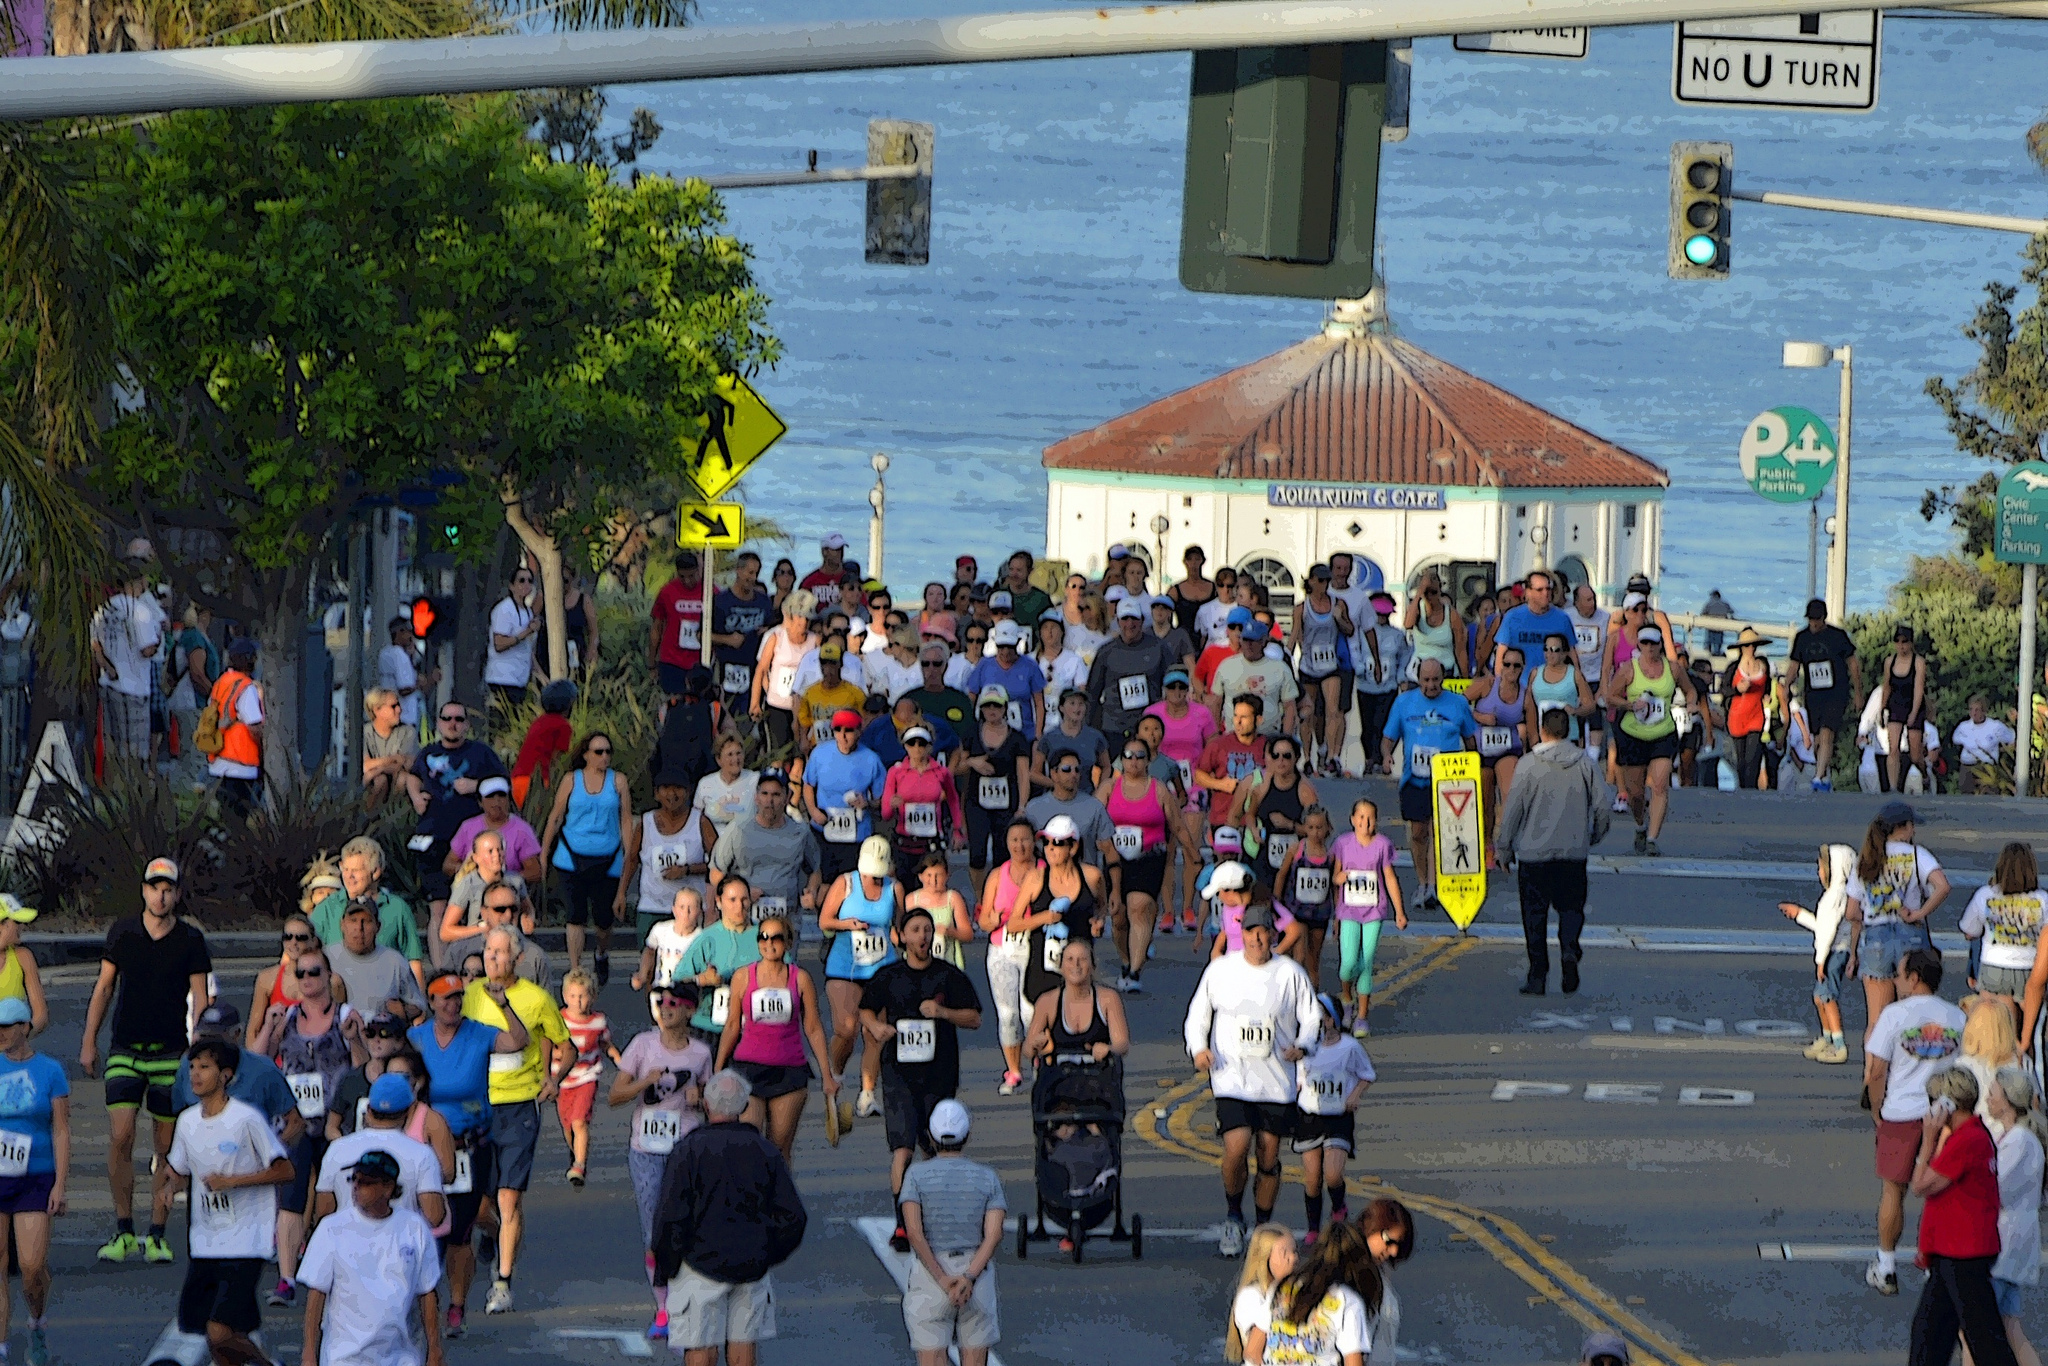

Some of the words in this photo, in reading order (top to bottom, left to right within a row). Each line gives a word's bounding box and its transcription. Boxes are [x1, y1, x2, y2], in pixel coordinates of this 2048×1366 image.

[1692, 57, 1730, 81] NO
[1743, 54, 1772, 88] U
[1784, 60, 1860, 87] TURN
[1740, 411, 1788, 481] P
[1759, 467, 1797, 480] Public
[1758, 480, 1806, 496] Parking
[1273, 485, 1368, 508] AQUARIUM
[2002, 495, 2030, 511] Civic
[2002, 510, 2040, 526] Center
[2001, 538, 2041, 558] Parking
[1441, 757, 1470, 767] STATE
[1445, 768, 1466, 777] LAW
[1490, 1080, 1756, 1108] PED
